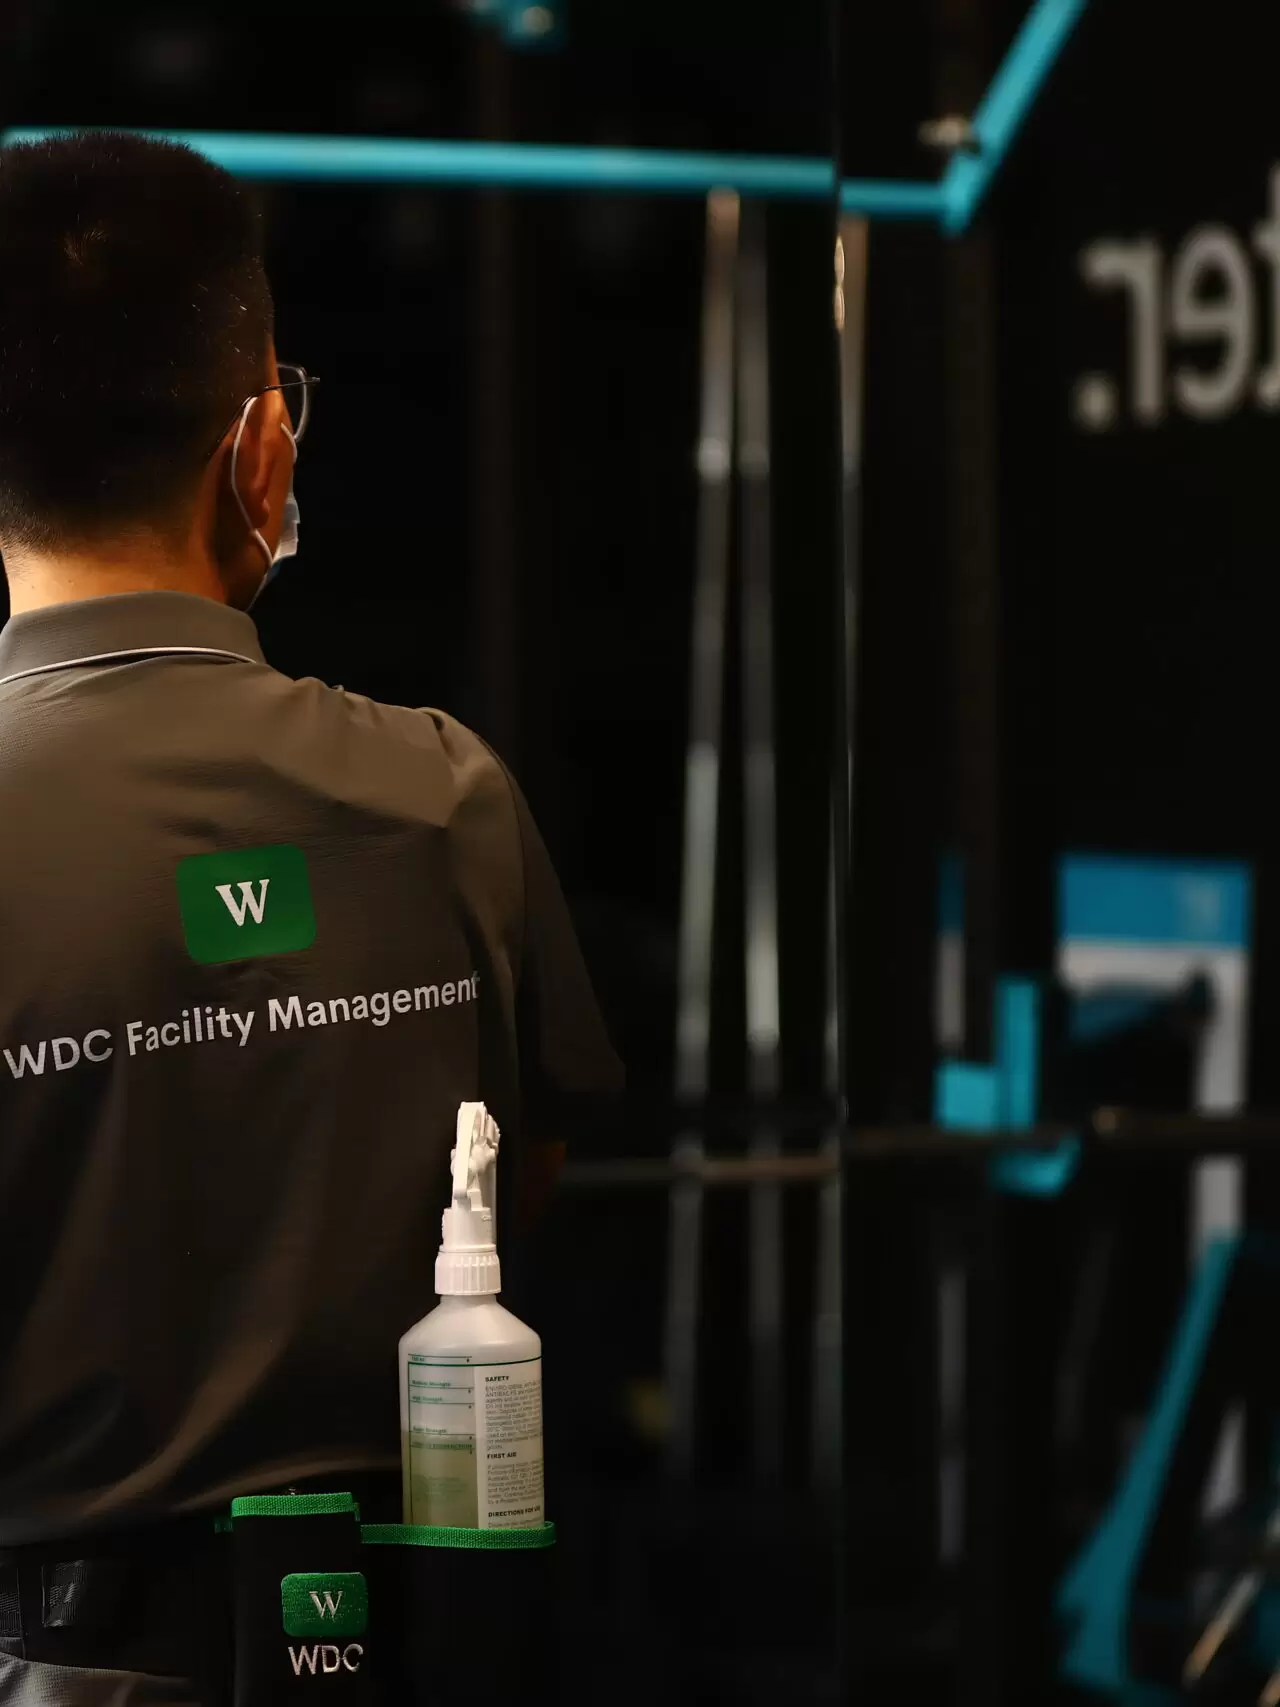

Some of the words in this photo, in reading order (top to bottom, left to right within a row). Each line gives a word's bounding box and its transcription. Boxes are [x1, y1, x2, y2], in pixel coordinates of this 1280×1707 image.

[214, 878, 270, 927] W
[2, 1027, 114, 1080] WDC
[125, 1005, 256, 1056] Facility
[267, 969, 481, 1033] Management
[488, 1509, 524, 1517] DIRECTIONS
[308, 1590, 344, 1621] W
[288, 1643, 364, 1676] WDC
